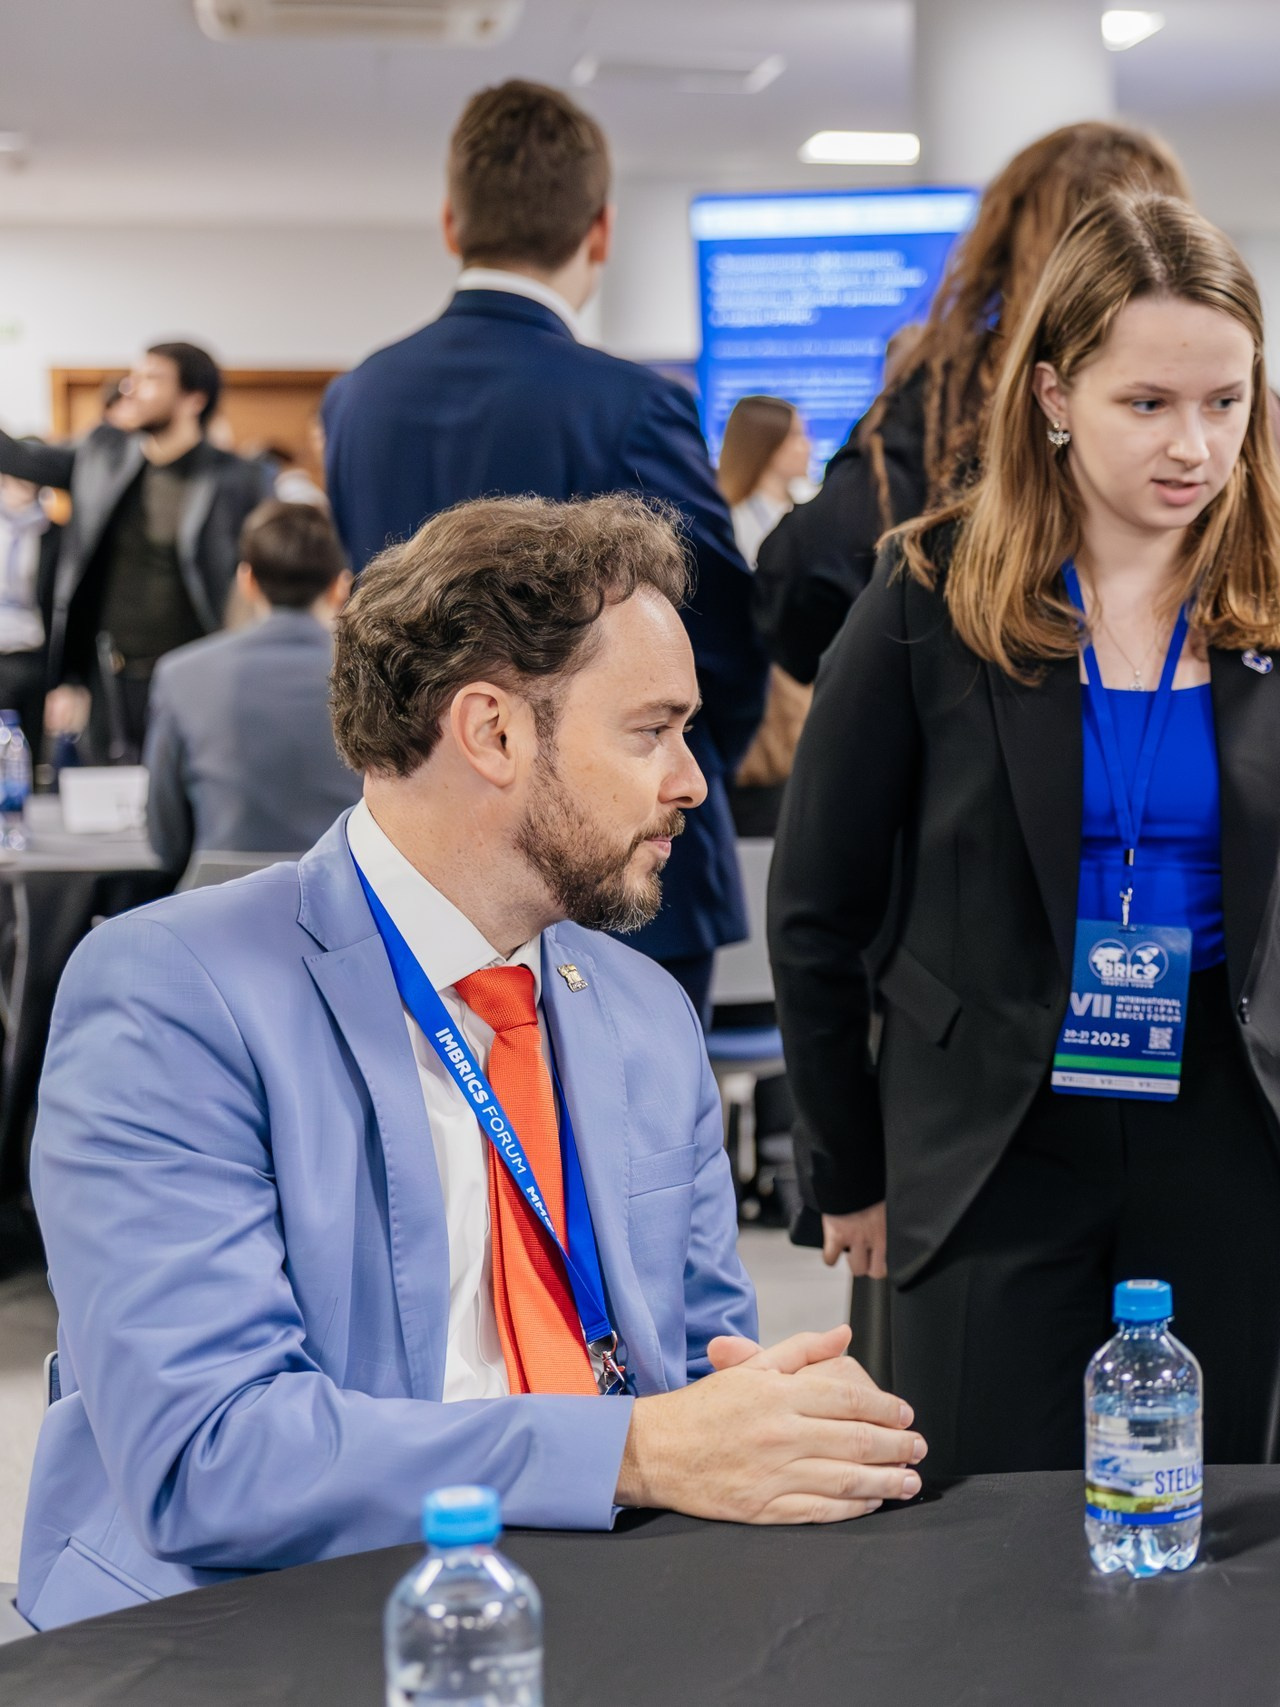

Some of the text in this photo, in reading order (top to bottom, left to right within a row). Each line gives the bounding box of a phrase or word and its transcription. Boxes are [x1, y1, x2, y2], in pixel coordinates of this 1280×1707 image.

[1101, 962, 1156, 980] BRICS
[1070, 992, 1112, 1018] VII
[1116, 1003, 1181, 1015] MUNICIPAL
[1146, 1013, 1181, 1023] FORUM
[1090, 1030, 1130, 1048] 2025
[435, 1027, 527, 1174] IMBRICS FORUM
